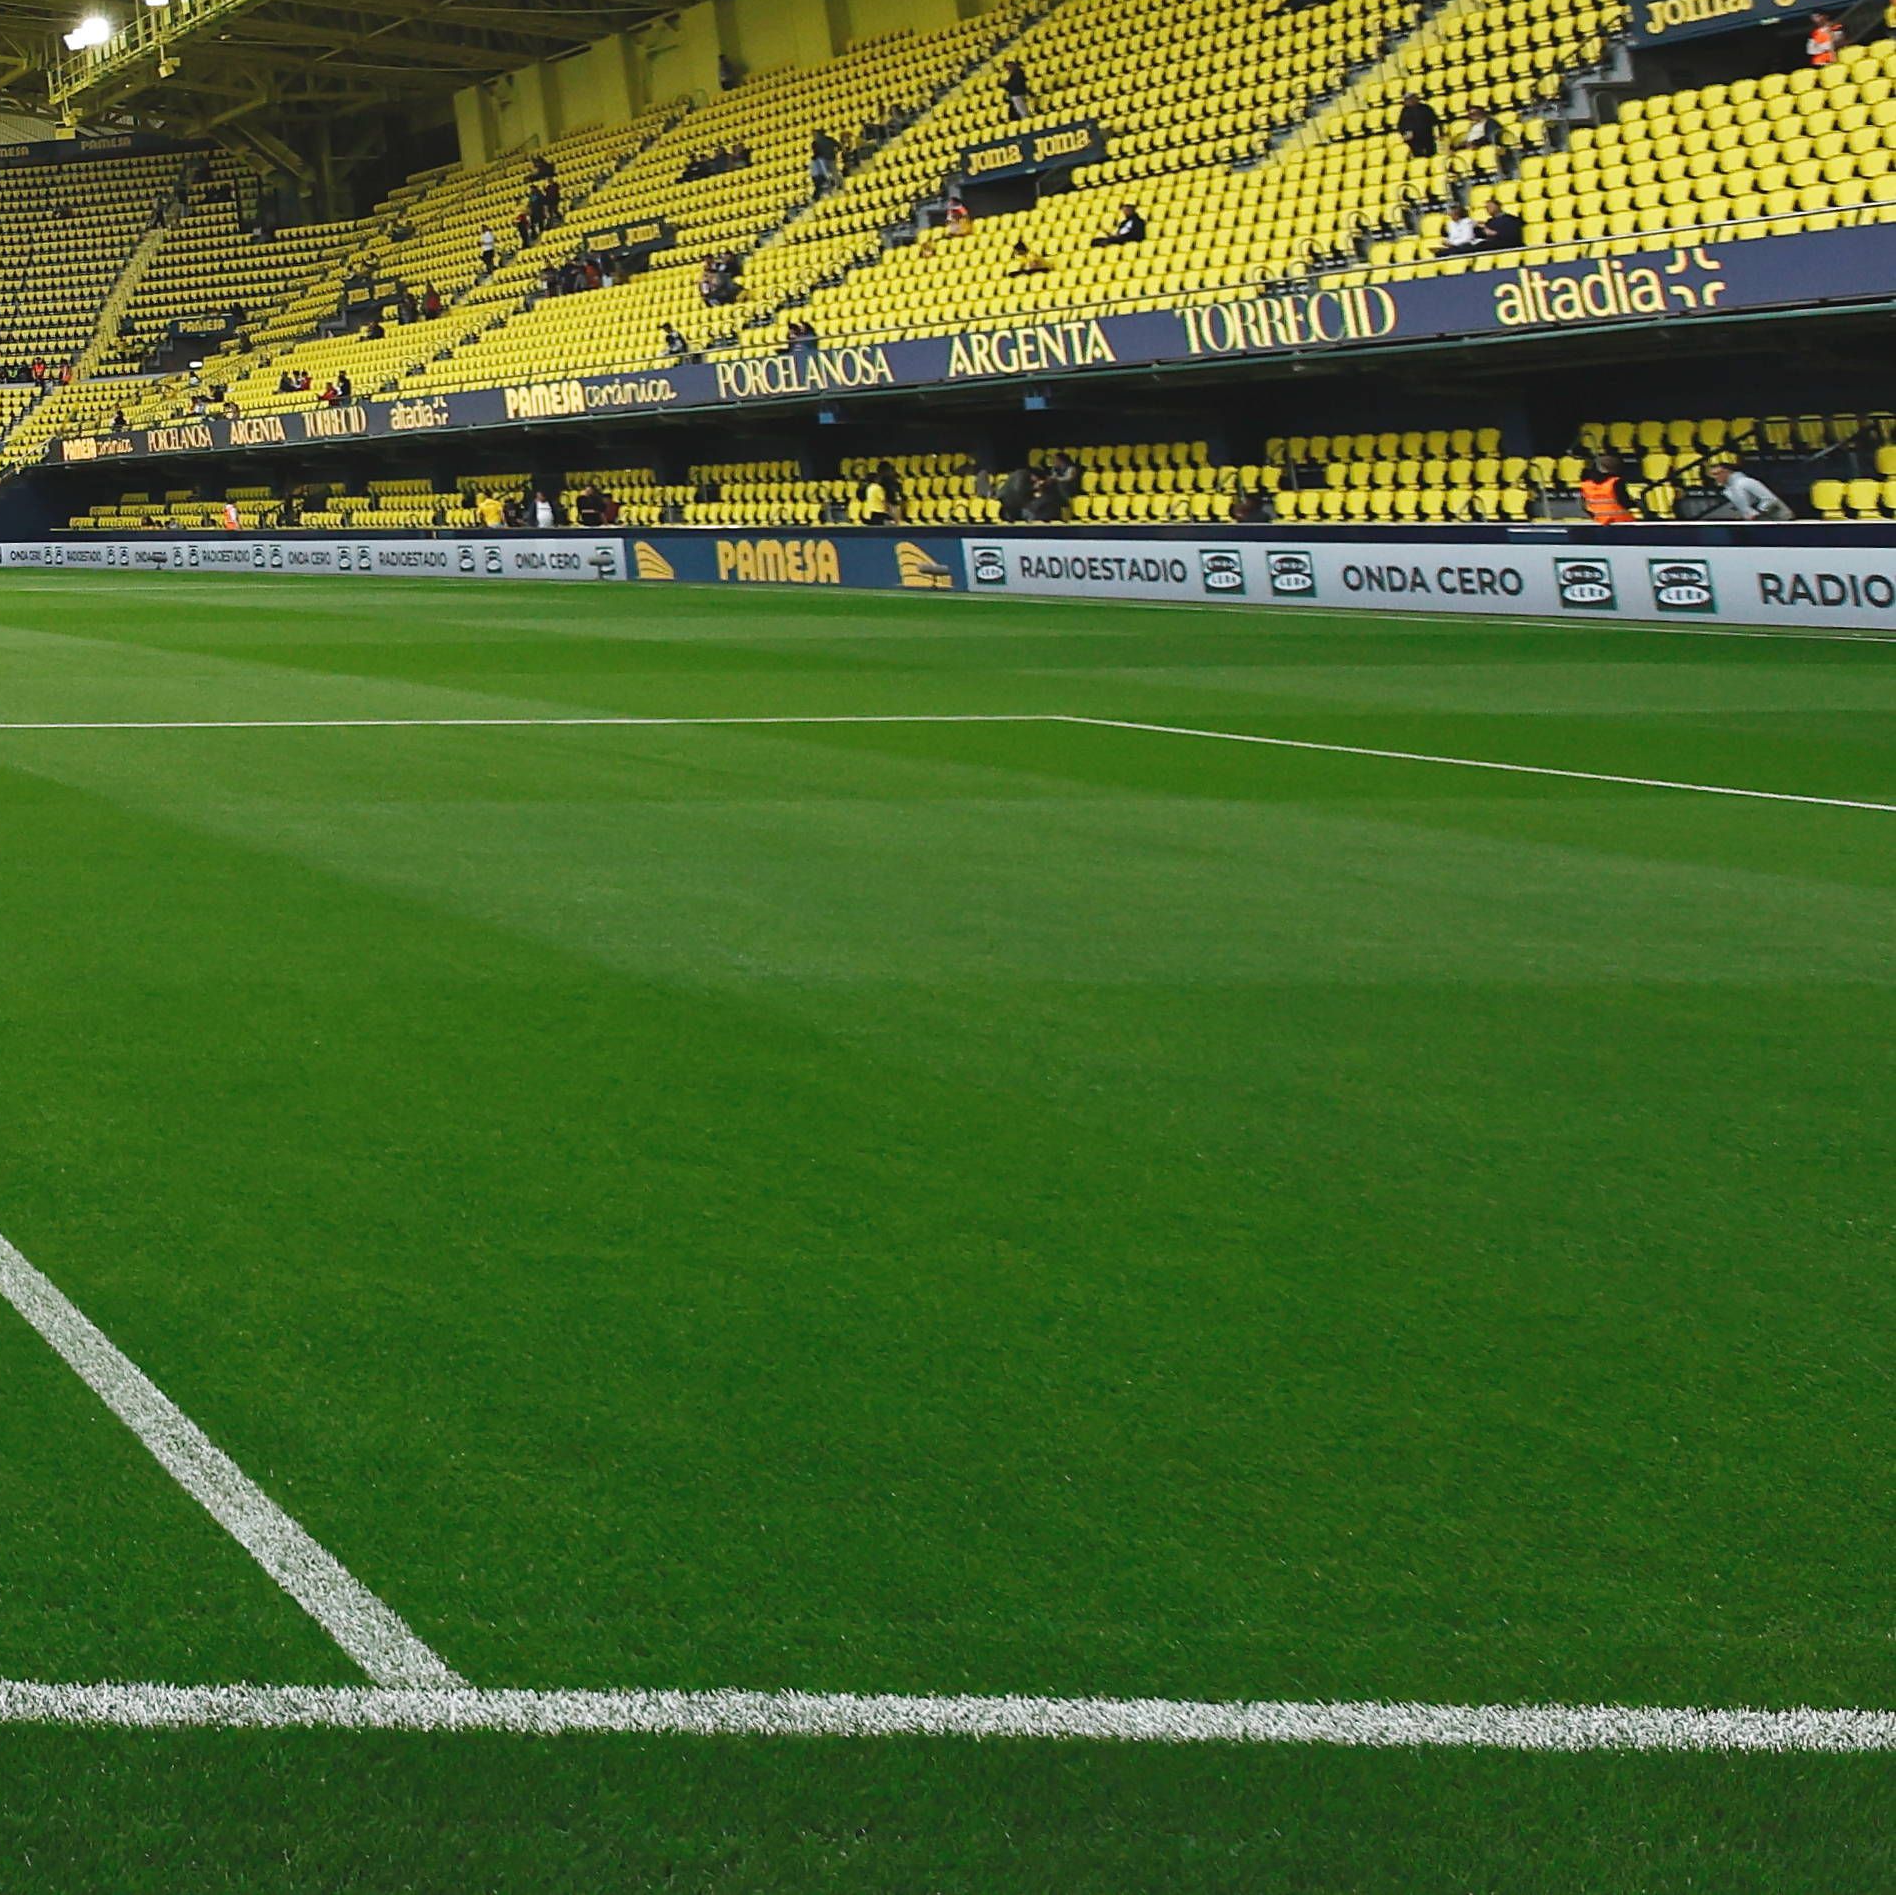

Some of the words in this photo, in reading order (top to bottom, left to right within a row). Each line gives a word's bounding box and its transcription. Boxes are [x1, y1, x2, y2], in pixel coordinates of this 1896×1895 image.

[80, 135, 132, 151] PAMESA
[1494, 258, 1669, 327] altadia
[178, 318, 226, 335] PAMESA
[1175, 285, 1397, 354] TORRECID
[947, 319, 1116, 378] ARGENTA
[715, 347, 896, 399] PORCELANOSA
[505, 379, 585, 419] PAMESA
[230, 416, 286, 445] ARGENTA
[302, 406, 366, 437] TORRECID
[390, 400, 434, 431] altadia
[147, 425, 213, 452] PORCELANOSA
[379, 552, 448, 567] RADIOESTADIO
[515, 553, 547, 569] ONDA
[550, 553, 581, 570] CERO
[716, 539, 841, 583] PAMESA
[1020, 555, 1187, 583] RADIOESTADIO
[1342, 564, 1431, 593] ONDA
[1437, 566, 1524, 596] CERO
[1757, 572, 1896, 608] RADIO
